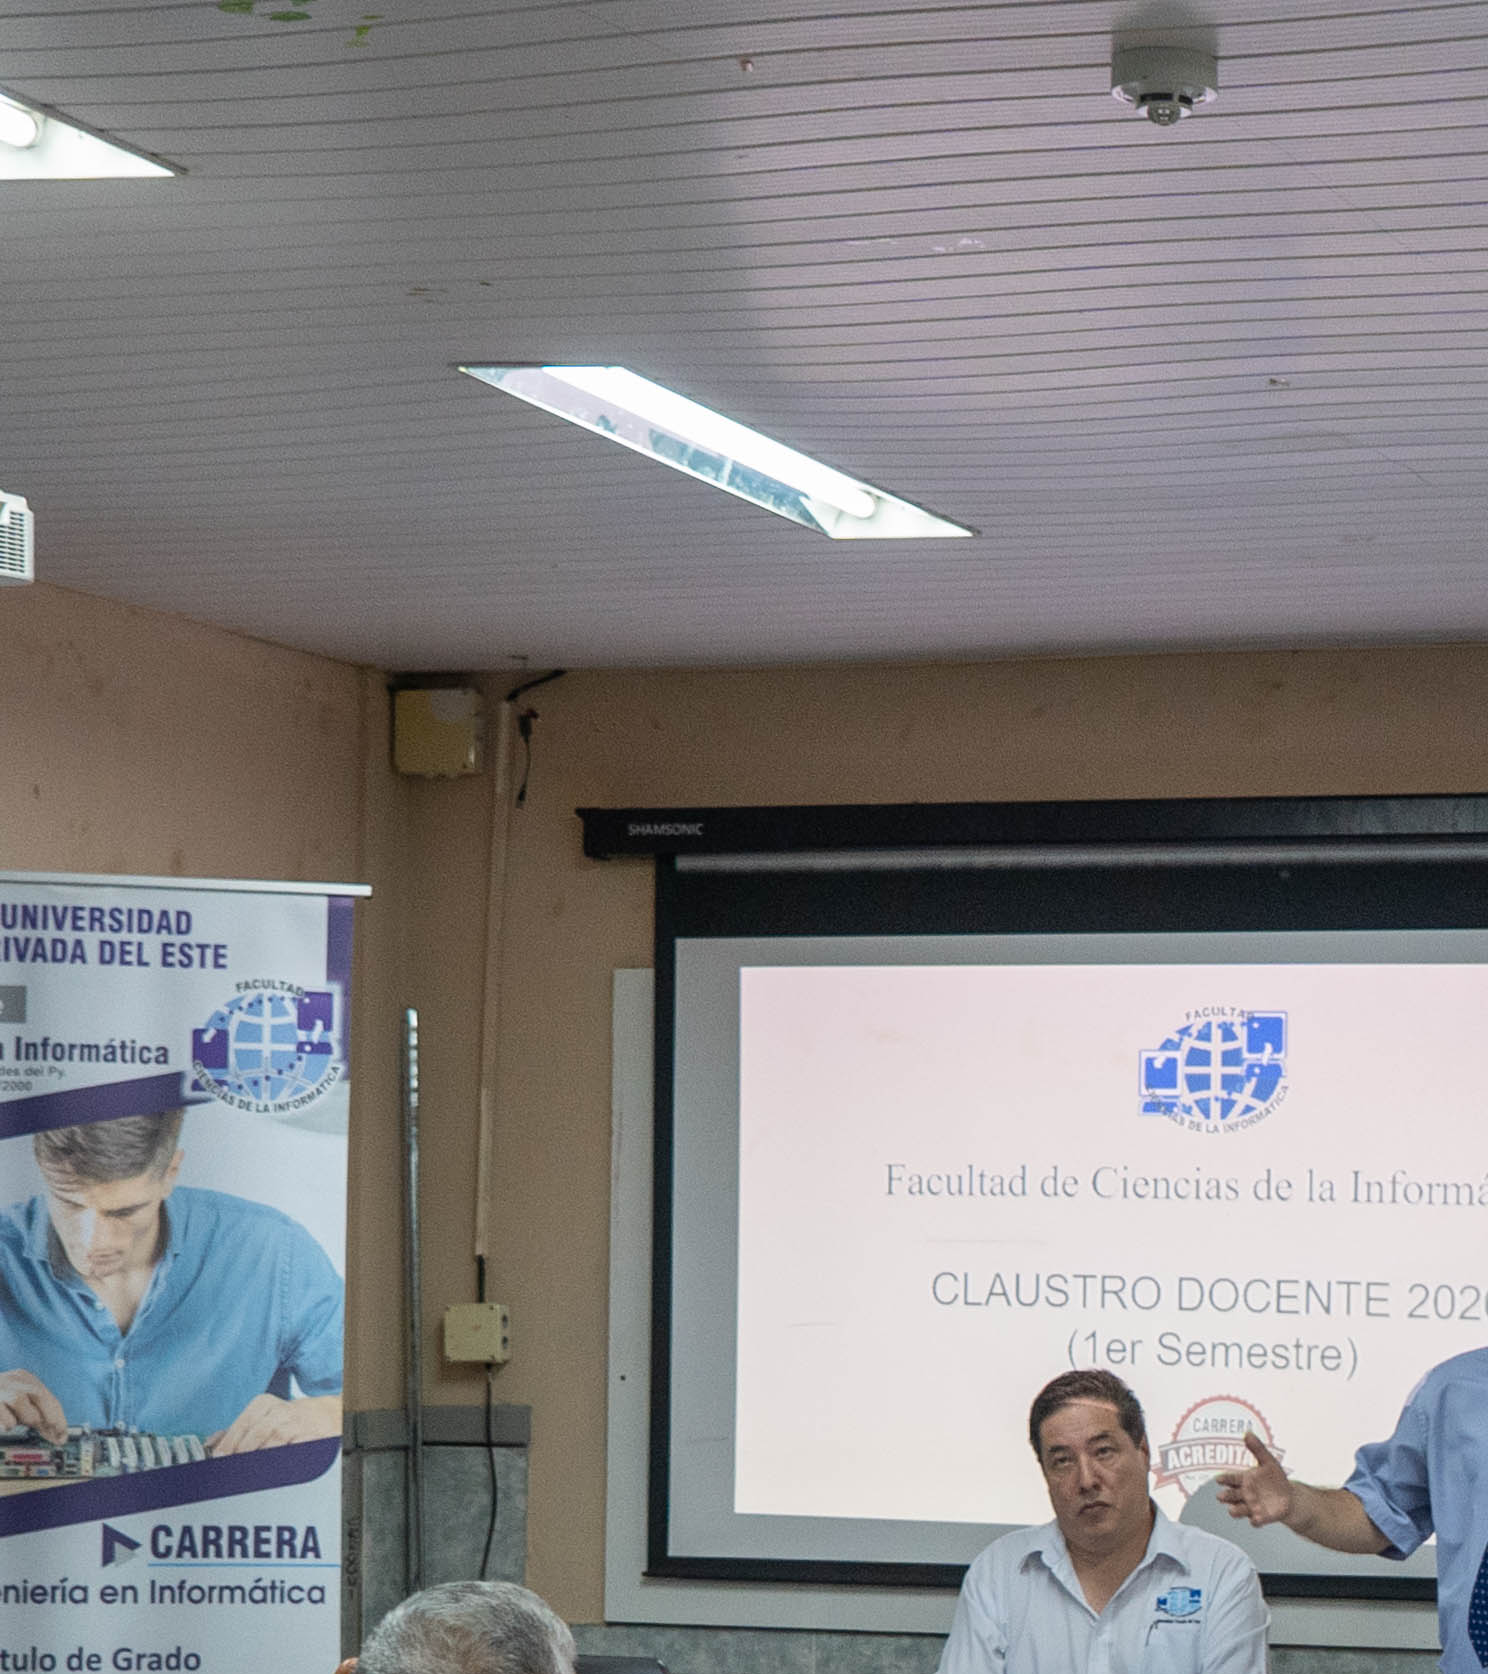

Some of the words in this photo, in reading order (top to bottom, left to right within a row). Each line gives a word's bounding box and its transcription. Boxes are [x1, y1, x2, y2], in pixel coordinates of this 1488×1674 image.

[0, 902, 193, 936] UNIVERSIDAD
[99, 940, 151, 969] DEL
[161, 942, 229, 971] ESTE
[235, 978, 306, 998] FACULTAD
[1185, 1006, 1255, 1022] FACULTAD
[14, 1035, 170, 1066] Informática
[237, 1098, 253, 1113] DE
[256, 1101, 271, 1114] LA
[273, 1064, 342, 1114] INFORMATICA
[1206, 1123, 1220, 1134] LA
[884, 1162, 1029, 1198] Facultad
[1039, 1166, 1080, 1200] de
[1091, 1166, 1241, 1203] Ciencias
[1252, 1168, 1294, 1202] de
[1306, 1169, 1337, 1204] la
[930, 1271, 1164, 1312] CLAUSTRO
[1177, 1276, 1392, 1319] DOCENTE
[1066, 1328, 1144, 1370] (1er
[1155, 1330, 1361, 1381] Semestre)
[1193, 1417, 1253, 1434] CARRERA
[1167, 1443, 1258, 1471] ACREDITA
[150, 1524, 322, 1560] CARRERA
[100, 1583, 139, 1606] en
[149, 1577, 326, 1606] Informática
[66, 1646, 104, 1674] de
[112, 1646, 202, 1674] Grado
